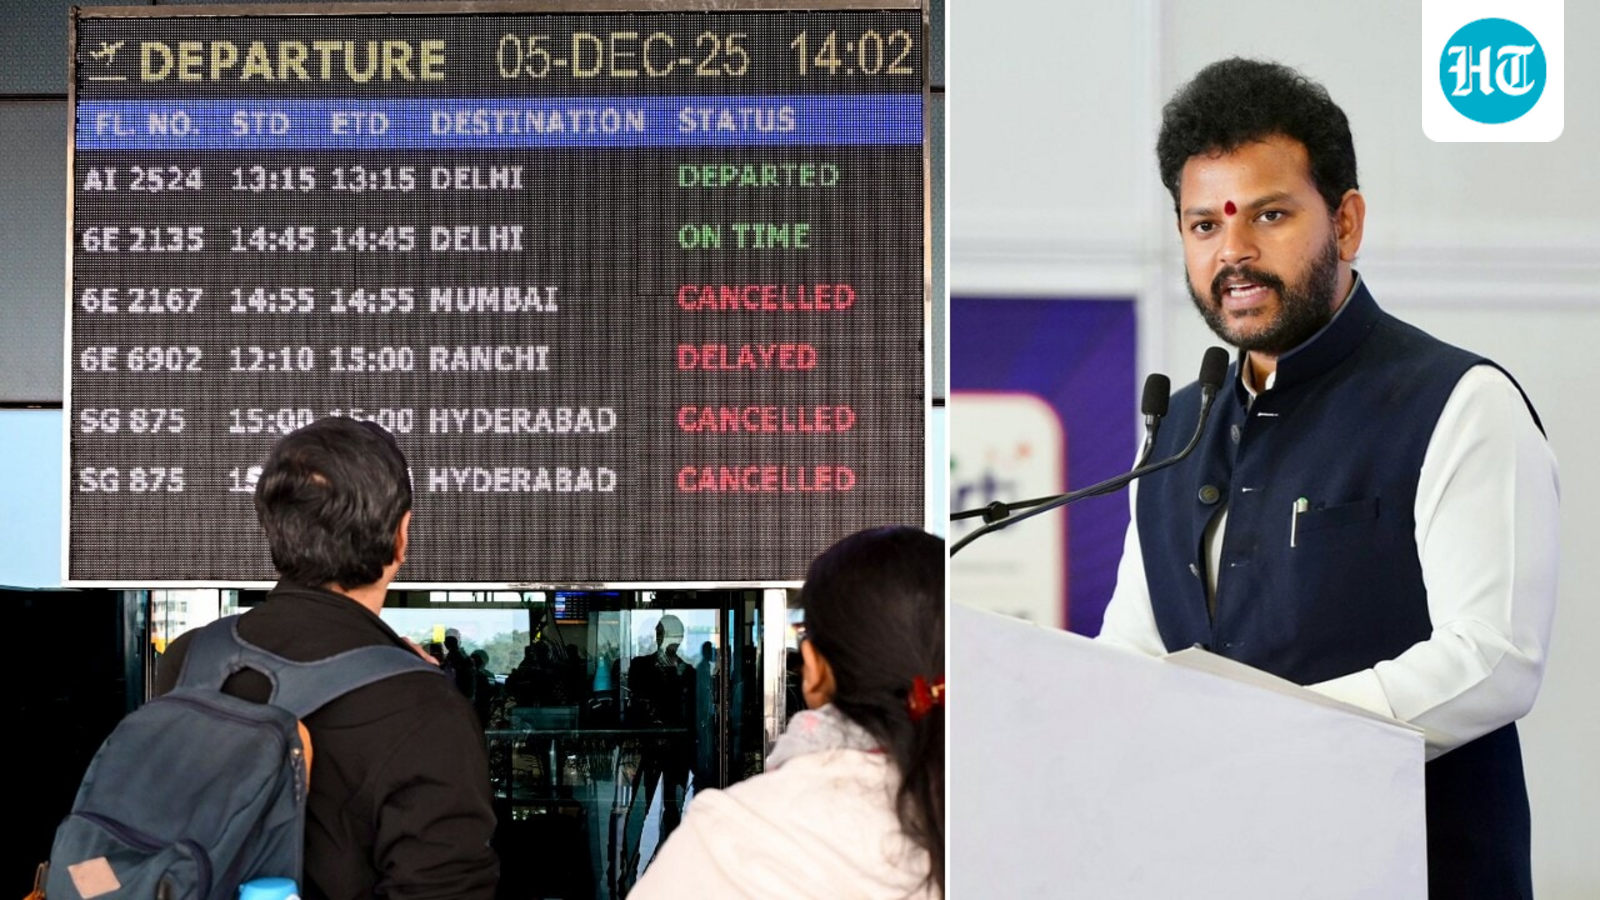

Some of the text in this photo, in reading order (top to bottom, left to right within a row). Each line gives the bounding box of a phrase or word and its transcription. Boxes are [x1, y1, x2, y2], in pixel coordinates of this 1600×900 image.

[140, 29, 914, 82] DEPARTURE 05-DEC-25 14:02
[148, 111, 200, 136] NO.
[232, 111, 291, 136] STD
[331, 111, 390, 136] ETD
[431, 109, 645, 135] DESTINATION
[678, 106, 796, 133] STATUS
[84, 163, 840, 192] AI 2524 13:15 13:15 DELHI DEPARTED
[82, 224, 811, 252] 6E 2135 14:45 14:45 DELHI ON TIME
[81, 285, 856, 313] 6E 2167 14:55 14:55 MUMBAI CANCELLED
[80, 344, 818, 372] 6E 6902 12:10 15:00 RANCHI DELAYED
[80, 408, 120, 434] SG
[129, 408, 186, 434] 875
[429, 408, 617, 433] HYDERABAD
[678, 406, 857, 433] CANCELLED
[79, 467, 120, 493] SG
[129, 467, 186, 493] 875
[428, 467, 617, 492] HYDERABAD
[678, 465, 857, 492] CANCELLED
